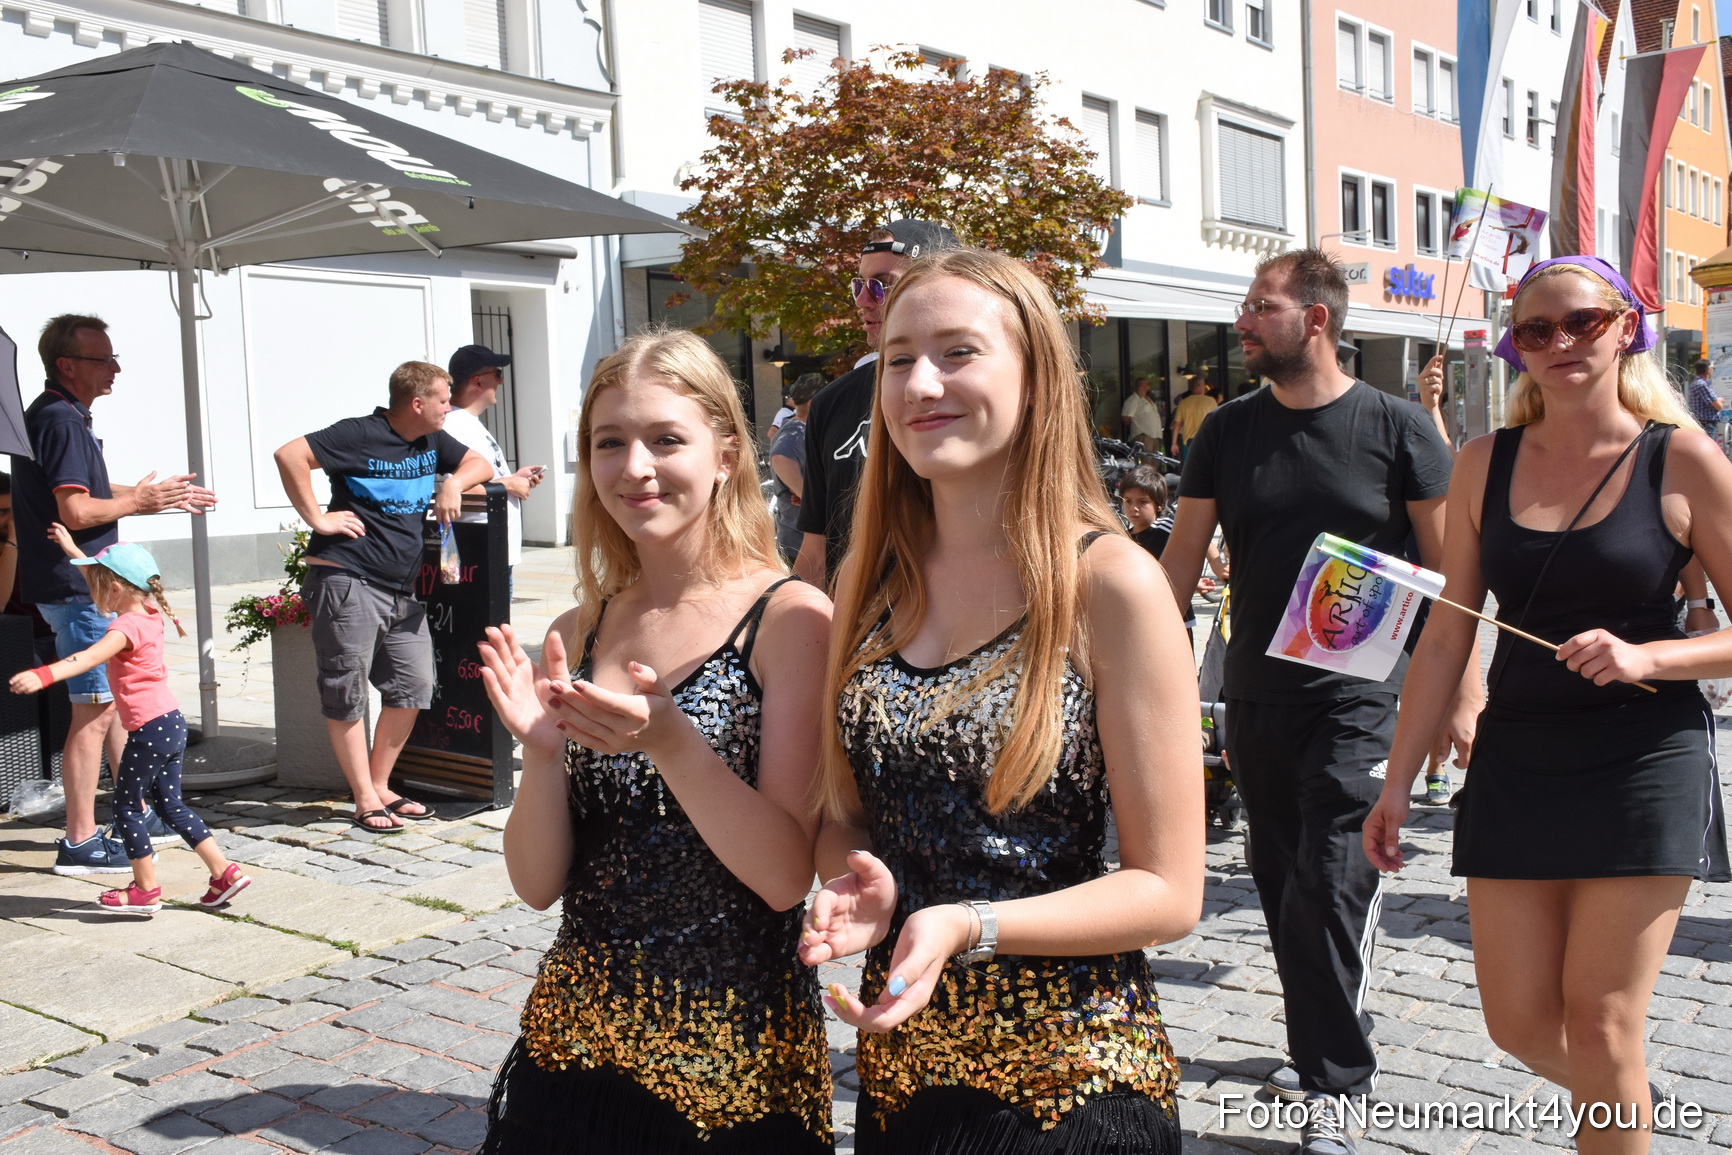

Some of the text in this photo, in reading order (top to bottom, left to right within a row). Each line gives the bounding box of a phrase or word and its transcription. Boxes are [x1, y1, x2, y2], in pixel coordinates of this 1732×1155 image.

[1343, 266, 1367, 281] tor.
[1319, 564, 1368, 649] ARTIC
[1351, 576, 1384, 646] art of spo
[1390, 590, 1415, 641] www.artico.
